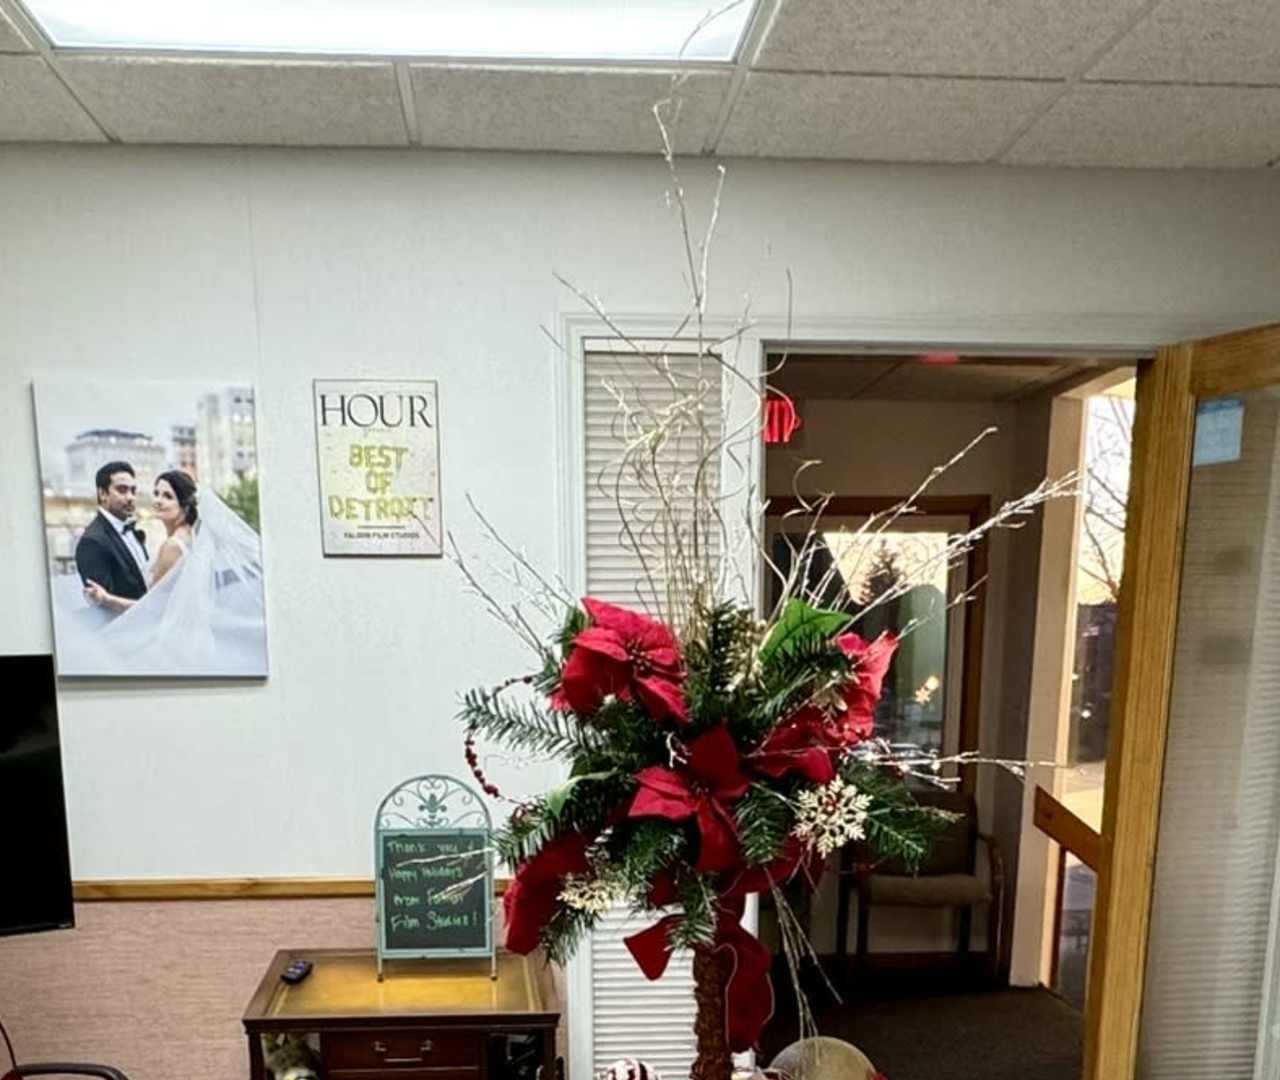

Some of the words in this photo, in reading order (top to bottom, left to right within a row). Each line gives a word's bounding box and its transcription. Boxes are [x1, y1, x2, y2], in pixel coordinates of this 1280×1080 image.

[319, 393, 433, 428] HOUR
[348, 443, 409, 470] BEST
[365, 470, 394, 495] OF
